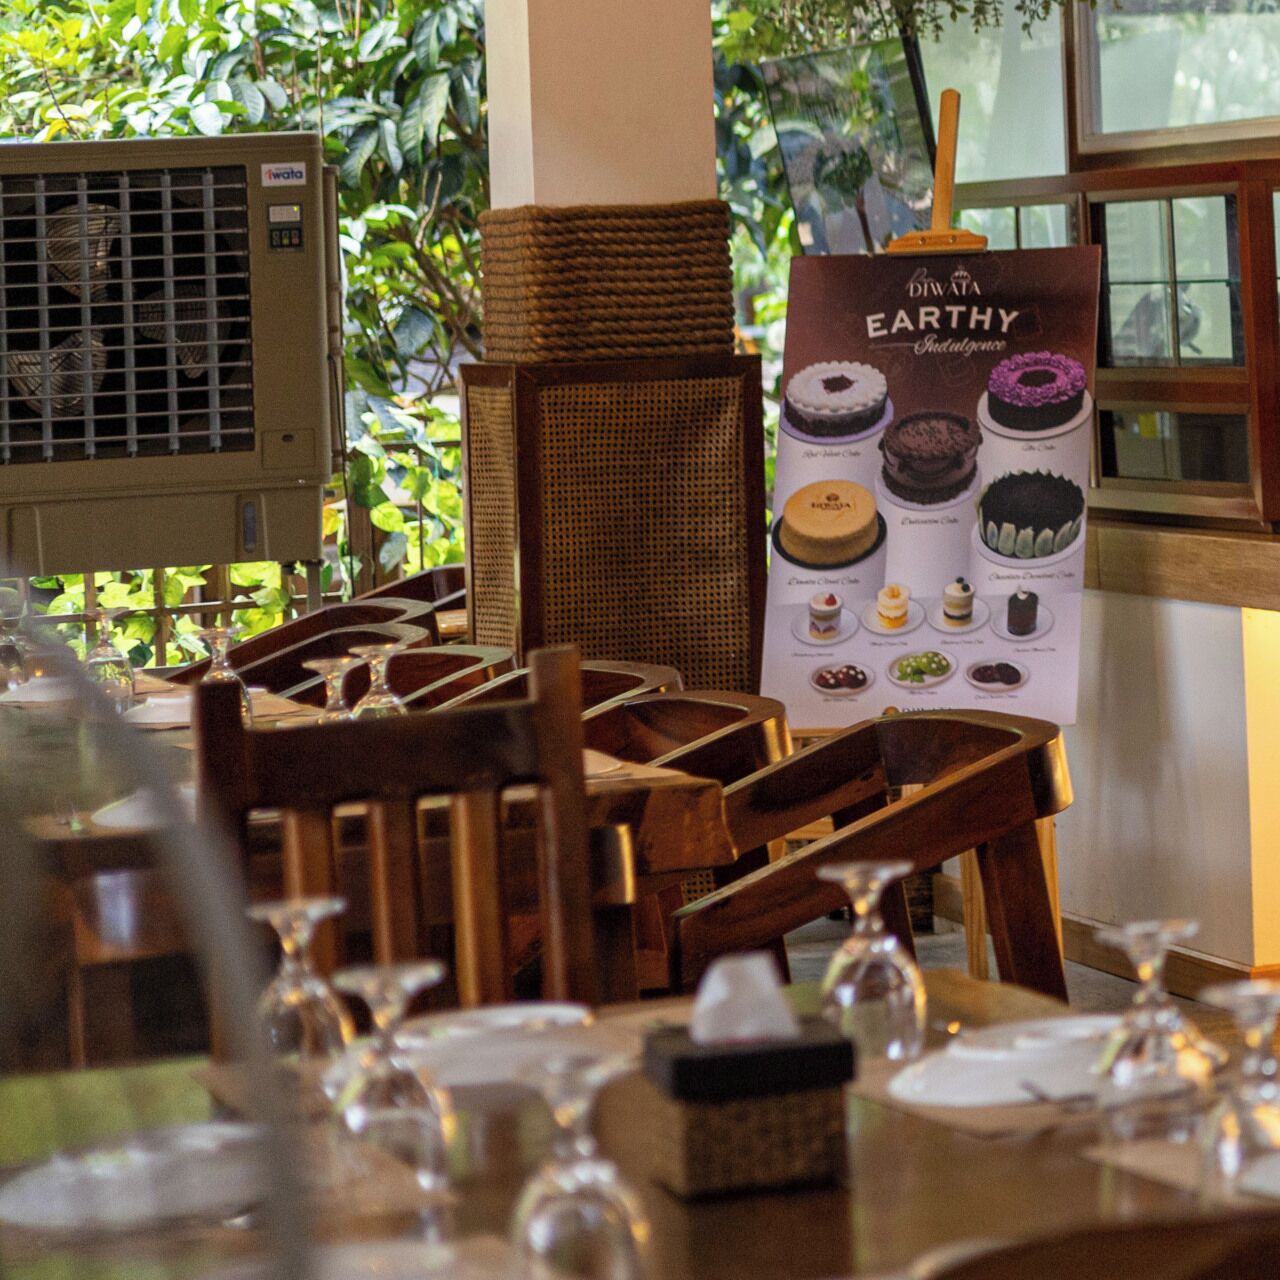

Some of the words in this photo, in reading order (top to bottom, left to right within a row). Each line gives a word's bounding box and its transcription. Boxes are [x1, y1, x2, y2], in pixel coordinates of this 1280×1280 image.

[909, 281, 982, 298] DIWATA
[866, 305, 1020, 339] EARTHY
[914, 333, 1006, 356] Indulgence
